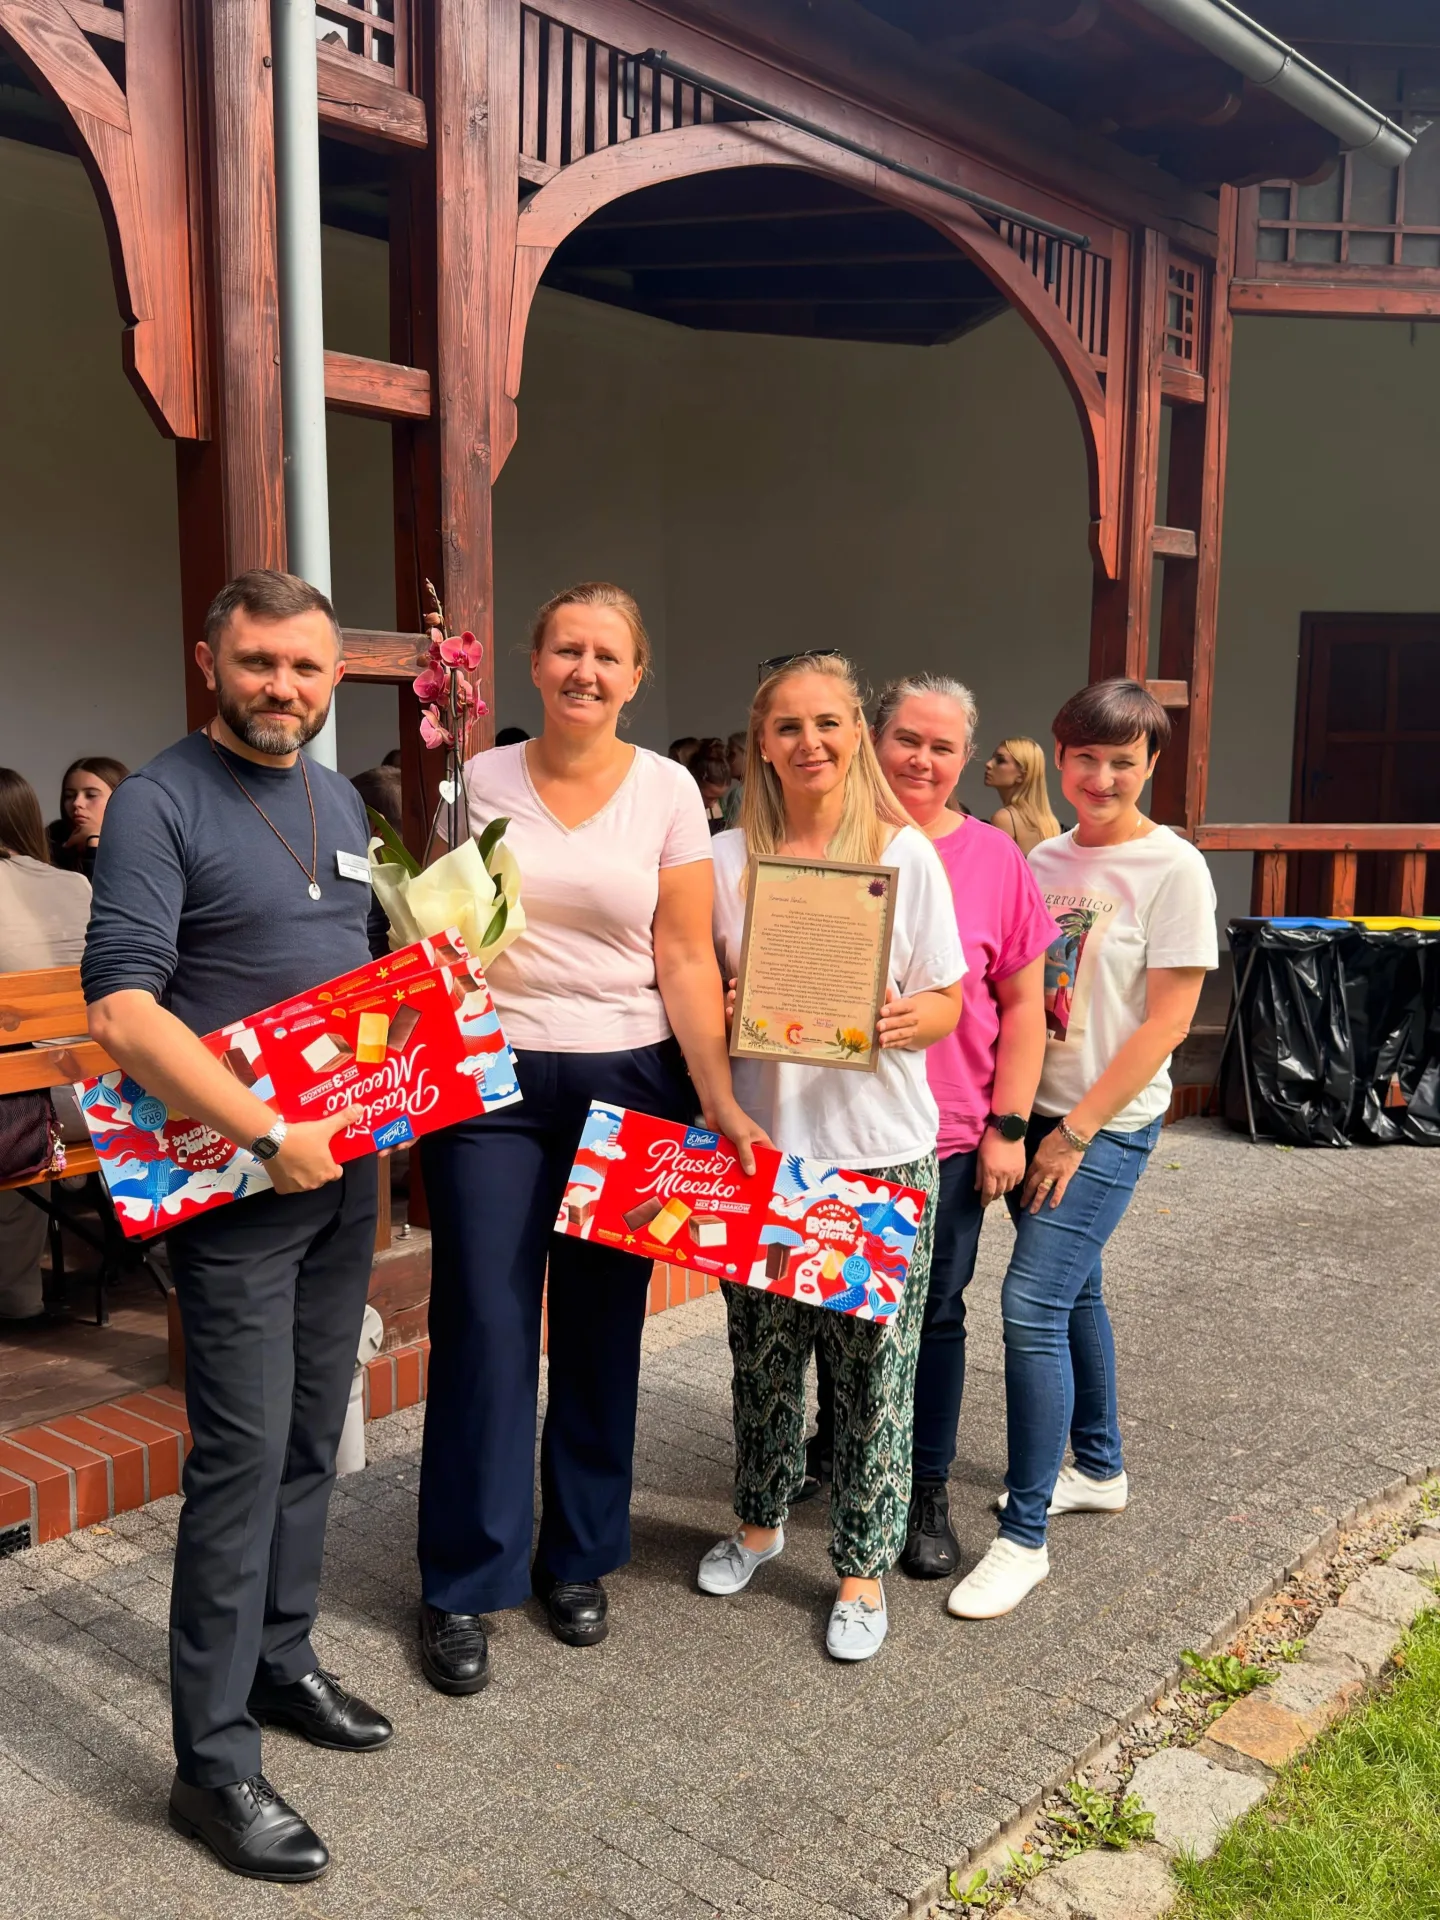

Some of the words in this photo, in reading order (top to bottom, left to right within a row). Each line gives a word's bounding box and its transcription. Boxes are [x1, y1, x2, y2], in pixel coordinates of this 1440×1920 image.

[1043, 893, 1076, 906] ERTO
[1079, 896, 1113, 913] RICO
[332, 1074, 343, 1088] 3
[343, 1068, 358, 1080] MIX
[300, 1081, 333, 1104] SMAKÓW
[140, 1112, 161, 1125] GRA
[177, 1130, 221, 1159] OMBO
[192, 1143, 232, 1166] ZAGRAJ
[645, 1139, 737, 1176] Ptasie
[709, 1199, 720, 1212] 3
[816, 1203, 852, 1217] ZAGRAJ
[805, 1216, 859, 1234] BOMBO
[848, 1260, 865, 1271] GRA
